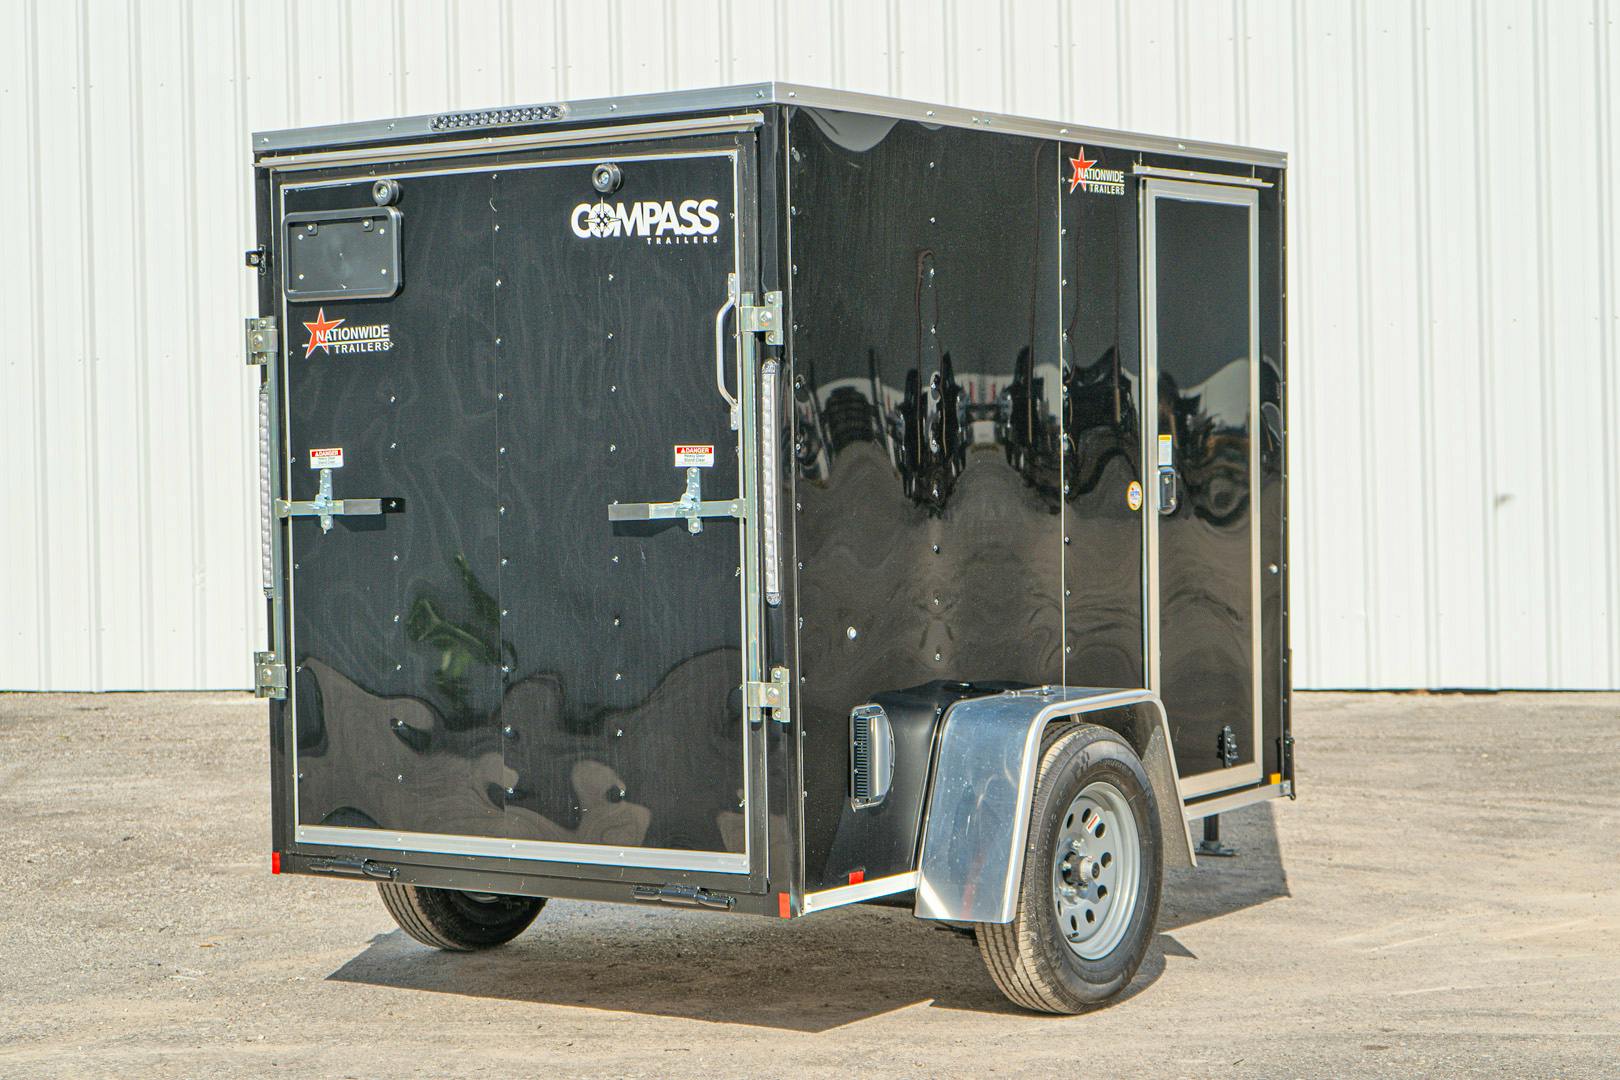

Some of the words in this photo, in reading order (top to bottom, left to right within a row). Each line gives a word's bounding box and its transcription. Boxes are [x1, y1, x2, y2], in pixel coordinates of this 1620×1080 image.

[1077, 167, 1125, 183] NATIONWIDE
[1089, 183, 1125, 195] TRAILERS
[570, 198, 720, 238] COMPASS
[646, 236, 719, 245] TRAILERS
[315, 324, 391, 342] NATIONWIDE
[334, 341, 390, 354] TRAILERS
